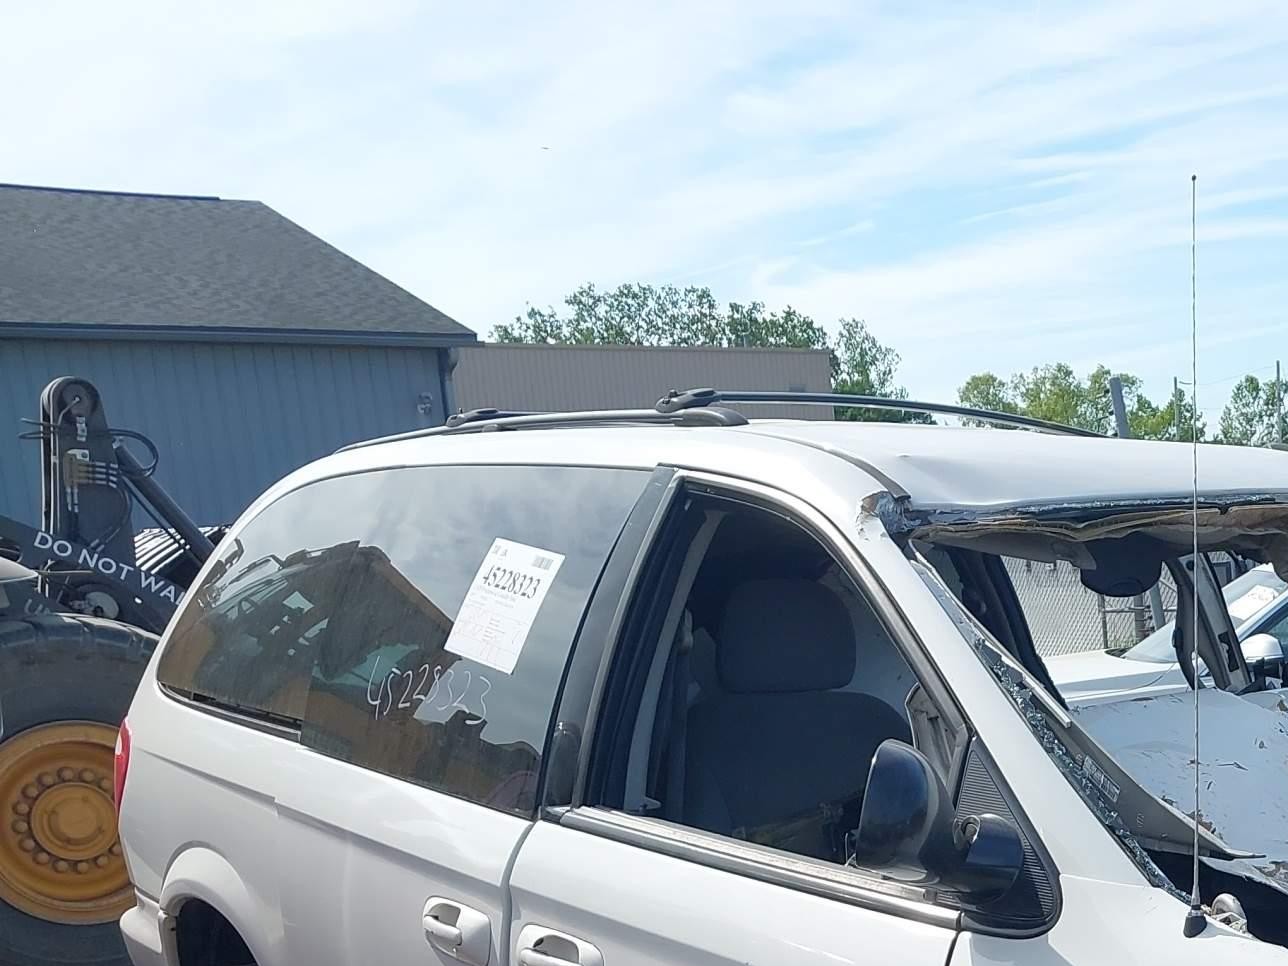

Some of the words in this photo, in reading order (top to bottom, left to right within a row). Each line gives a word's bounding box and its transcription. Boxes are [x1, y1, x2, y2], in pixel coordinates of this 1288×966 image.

[33, 531, 72, 557] DO
[78, 548, 134, 581] NOT
[483, 565, 541, 599] 45228323
[367, 656, 491, 725] 45228323
